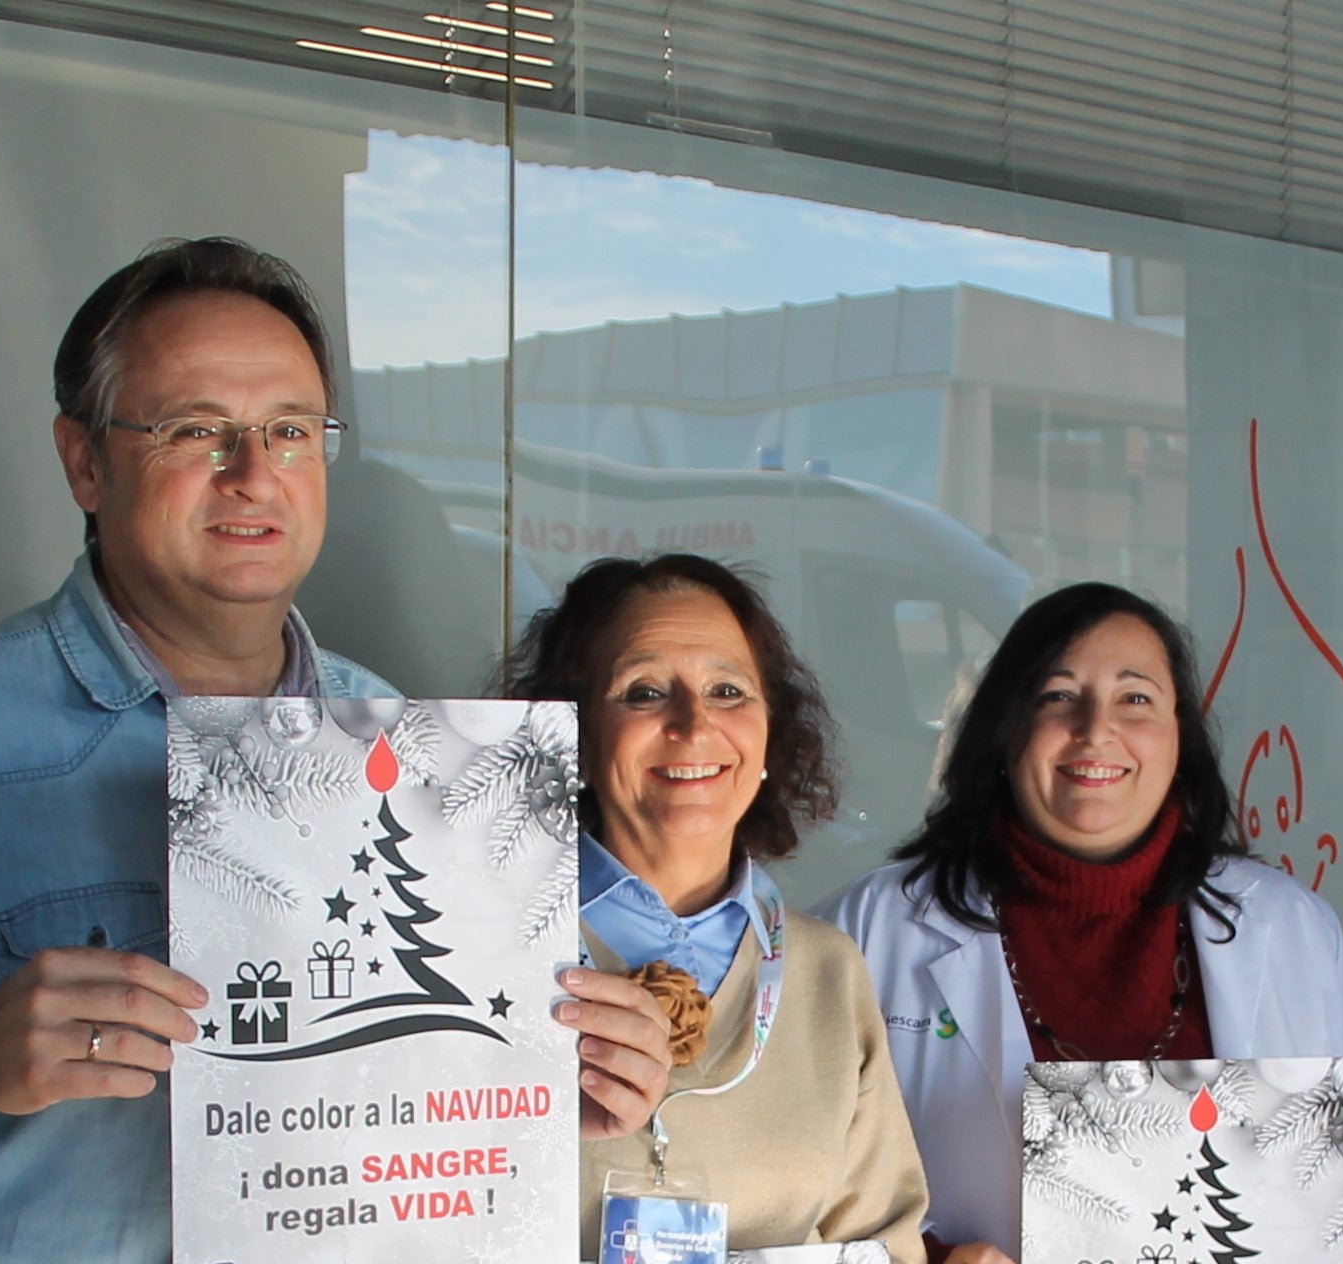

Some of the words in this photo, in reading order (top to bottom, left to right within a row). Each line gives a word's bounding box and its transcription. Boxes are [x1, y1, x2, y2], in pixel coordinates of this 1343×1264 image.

[205, 1102, 271, 1135] Dale
[282, 1098, 355, 1131] color
[365, 1103, 380, 1126] a
[391, 1094, 415, 1125] la
[426, 1086, 550, 1122] NAVIDAD
[263, 1163, 348, 1189] dona
[362, 1148, 517, 1183] SANGRE,
[266, 1199, 378, 1235] regala
[390, 1191, 474, 1221] VIDA
